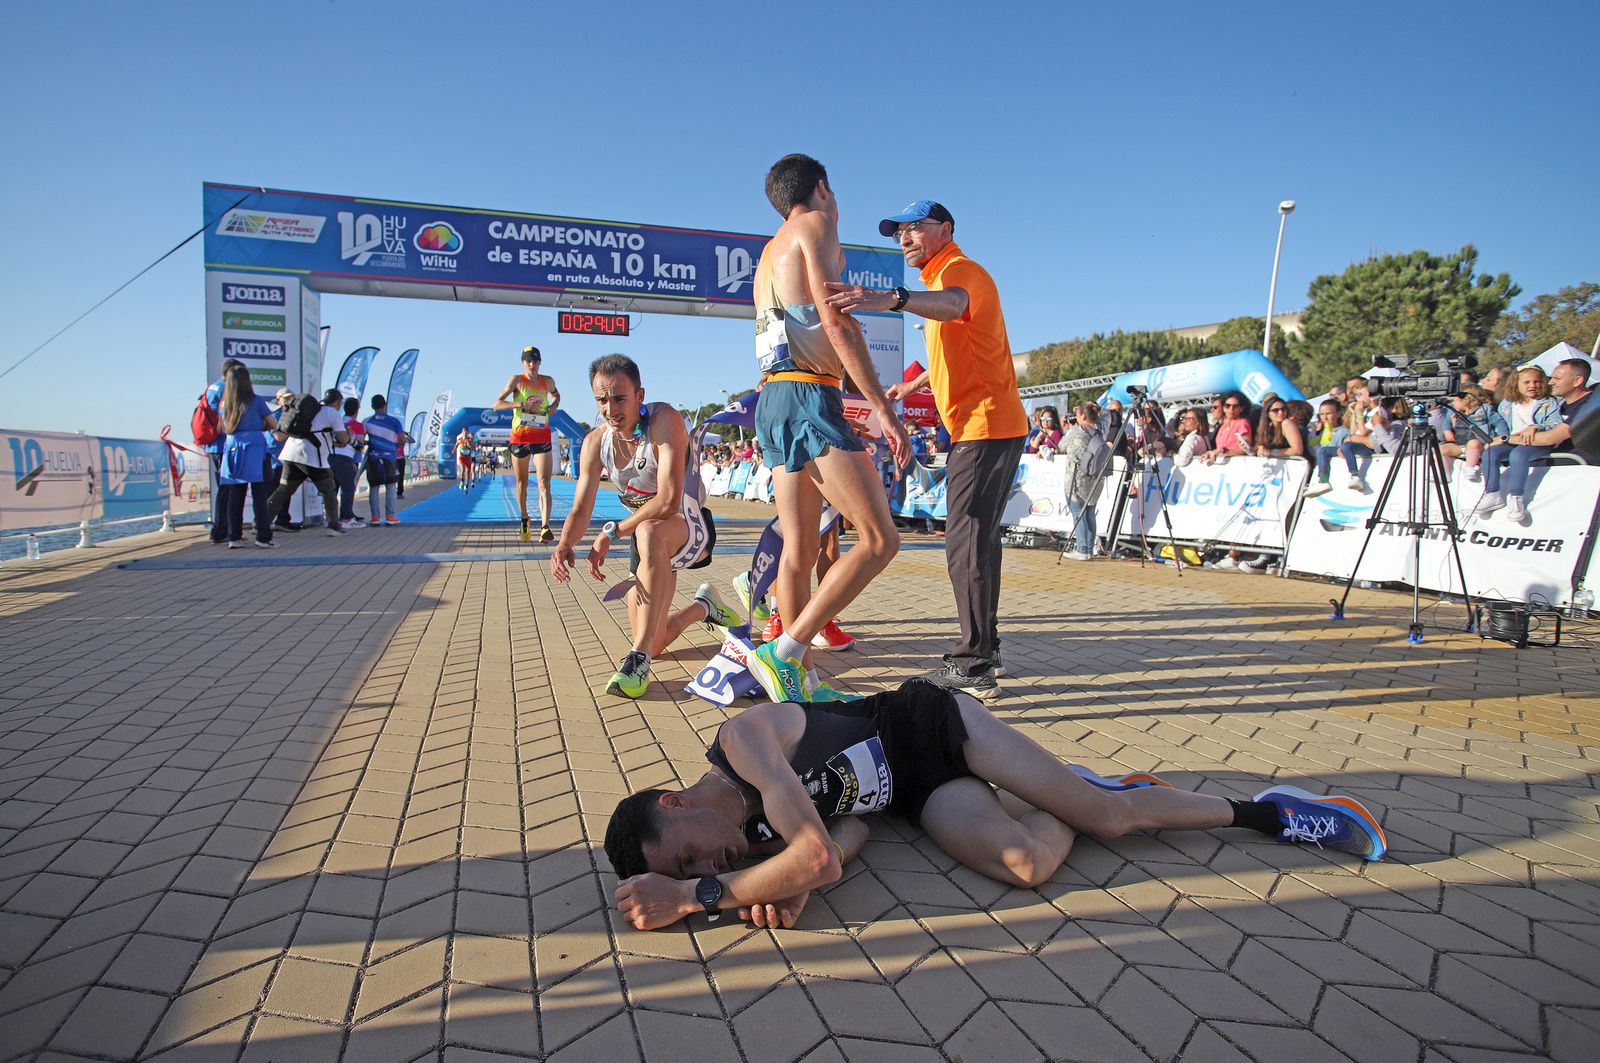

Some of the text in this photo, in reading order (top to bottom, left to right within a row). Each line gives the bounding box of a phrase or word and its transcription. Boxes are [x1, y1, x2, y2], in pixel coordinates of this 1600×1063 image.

[488, 221, 645, 250] CAMPEONATO
[420, 254, 457, 268] WiHu
[487, 246, 696, 280] de ESPAÑA 10 km
[547, 274, 696, 291] en ruta Absoluto y Master
[848, 269, 893, 289] WiHu
[241, 319, 282, 328] IBERDROLA
[869, 343, 899, 352] HUELVA
[430, 409, 442, 436] CSIF
[1144, 473, 1268, 508] Huelva
[1471, 530, 1564, 553] COPPER
[859, 789, 877, 806] 4
